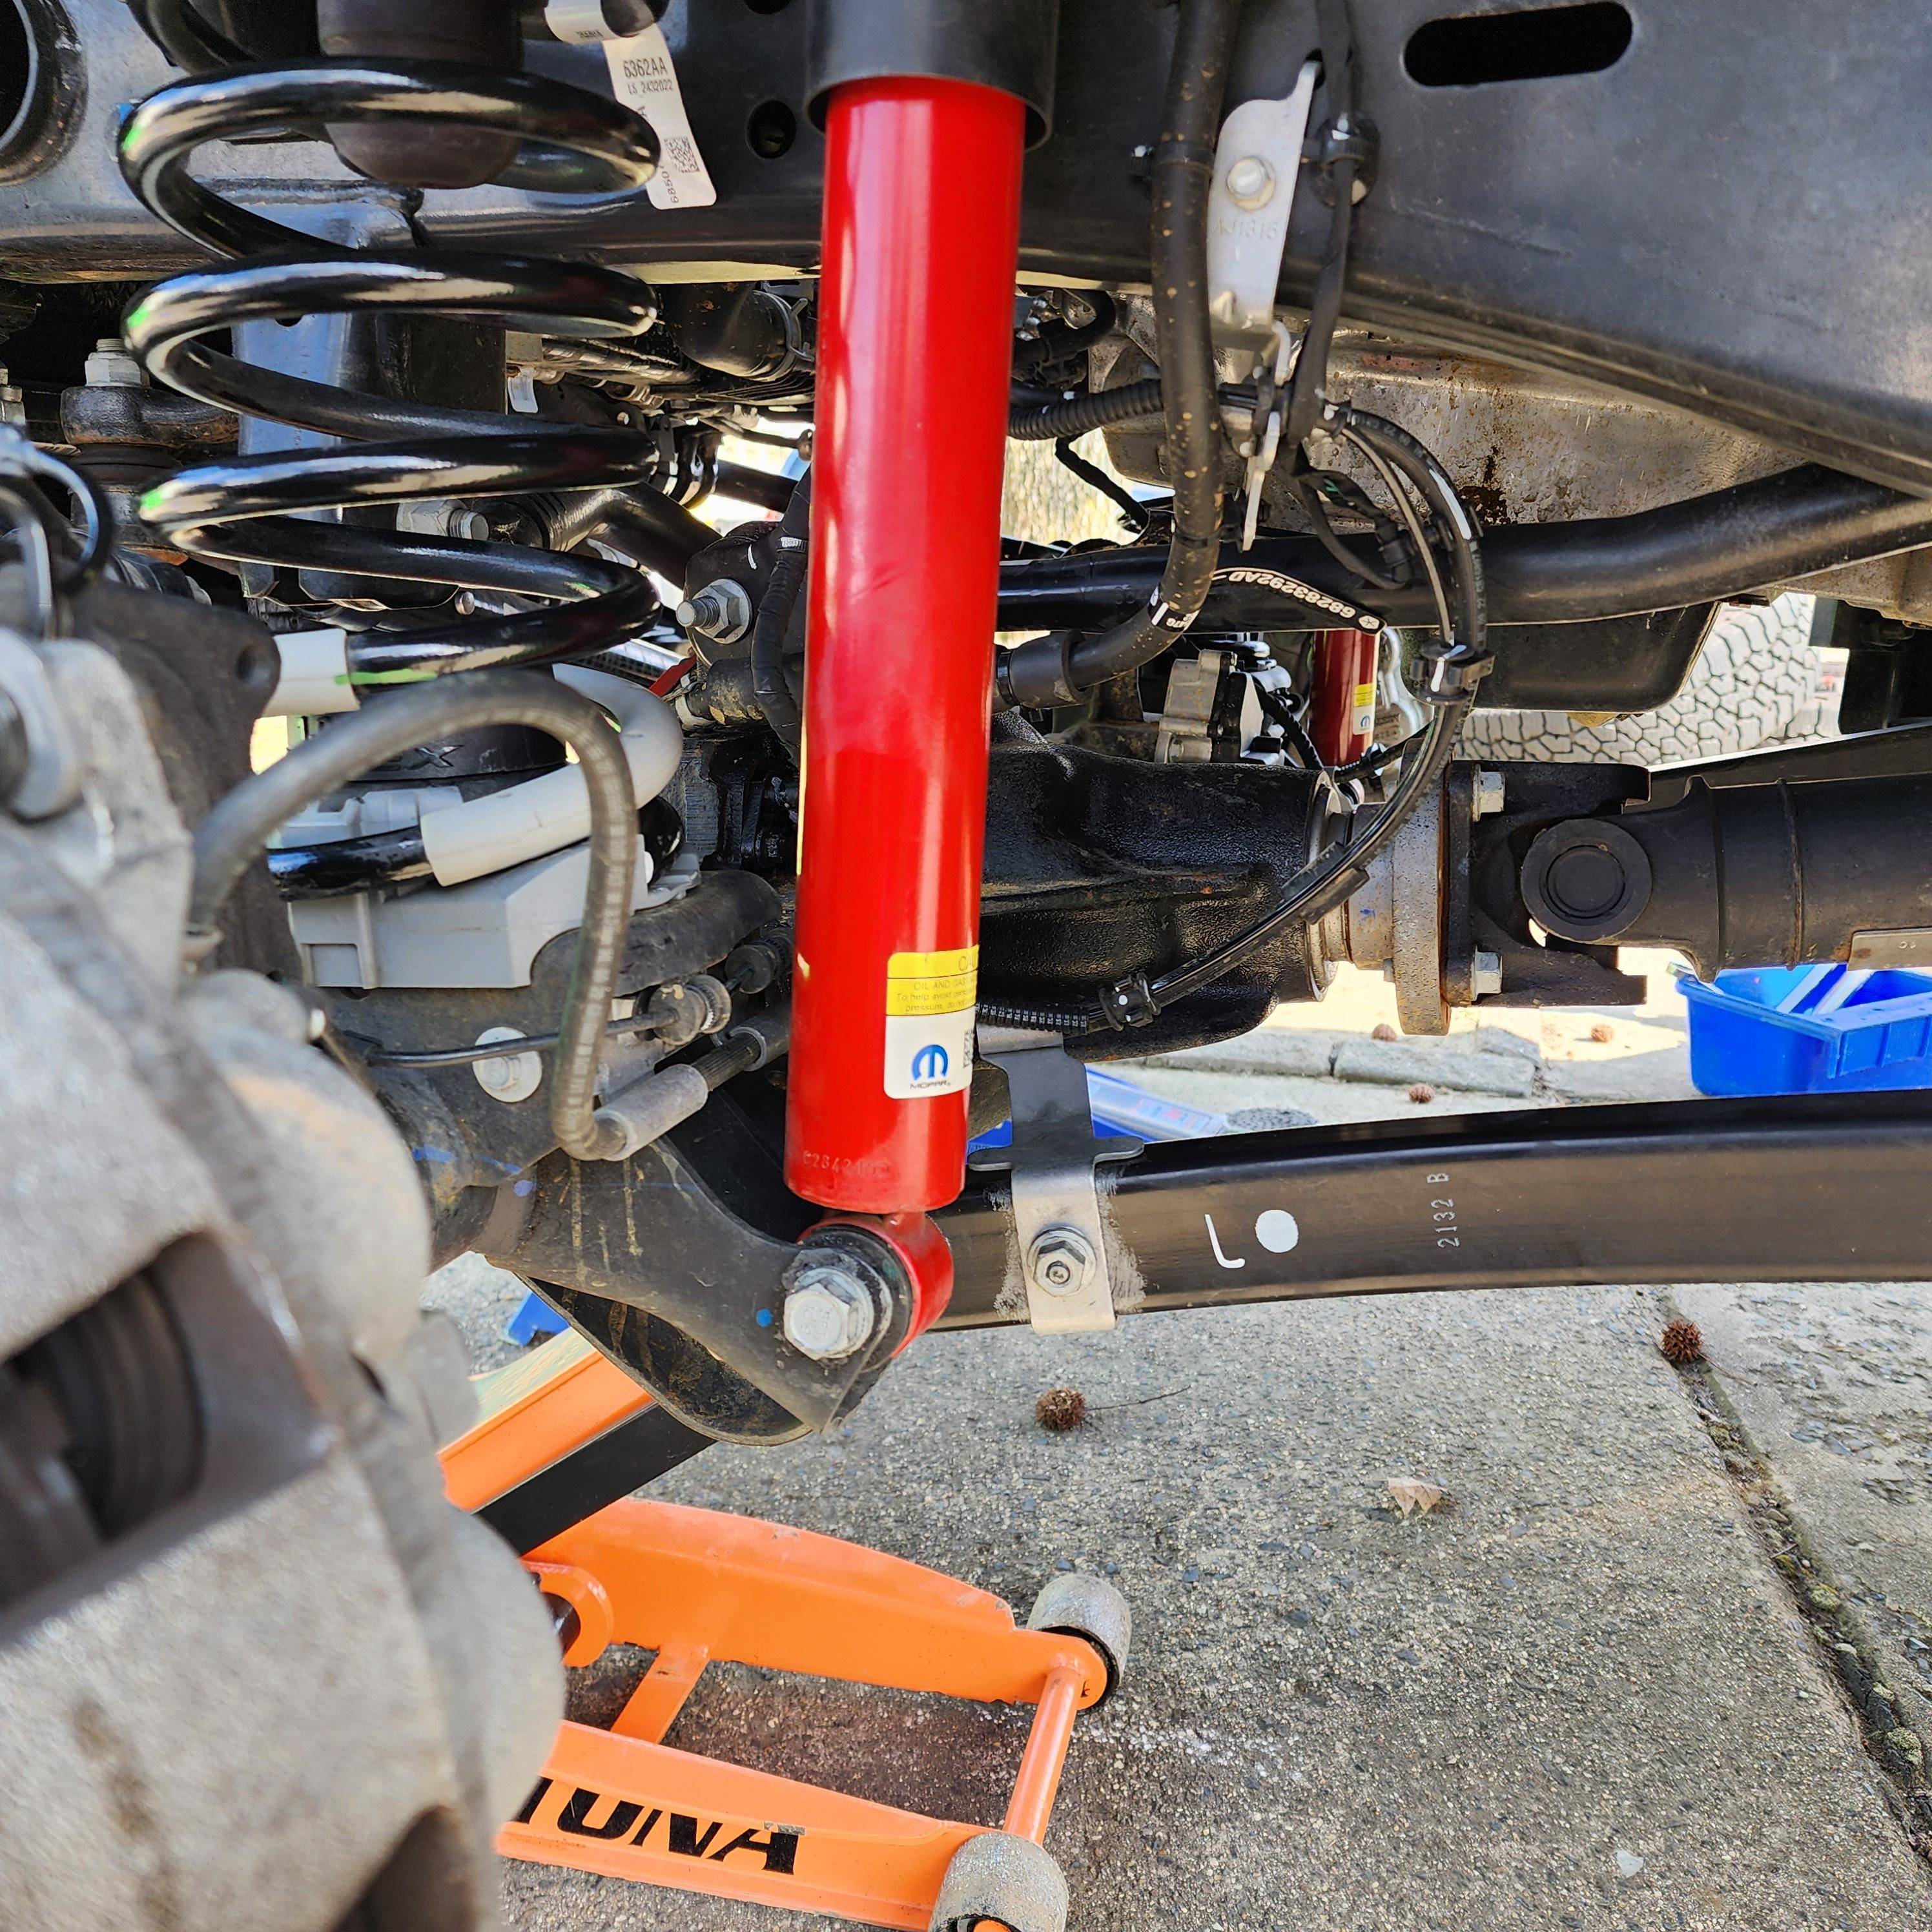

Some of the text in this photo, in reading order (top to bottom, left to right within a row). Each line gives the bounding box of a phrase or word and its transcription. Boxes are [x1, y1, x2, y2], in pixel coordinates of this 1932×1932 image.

[622, 56, 668, 78] 6362AA
[1228, 571, 1356, 619] 68283292AD
[914, 981, 929, 991] OIL
[933, 980, 951, 989] AND
